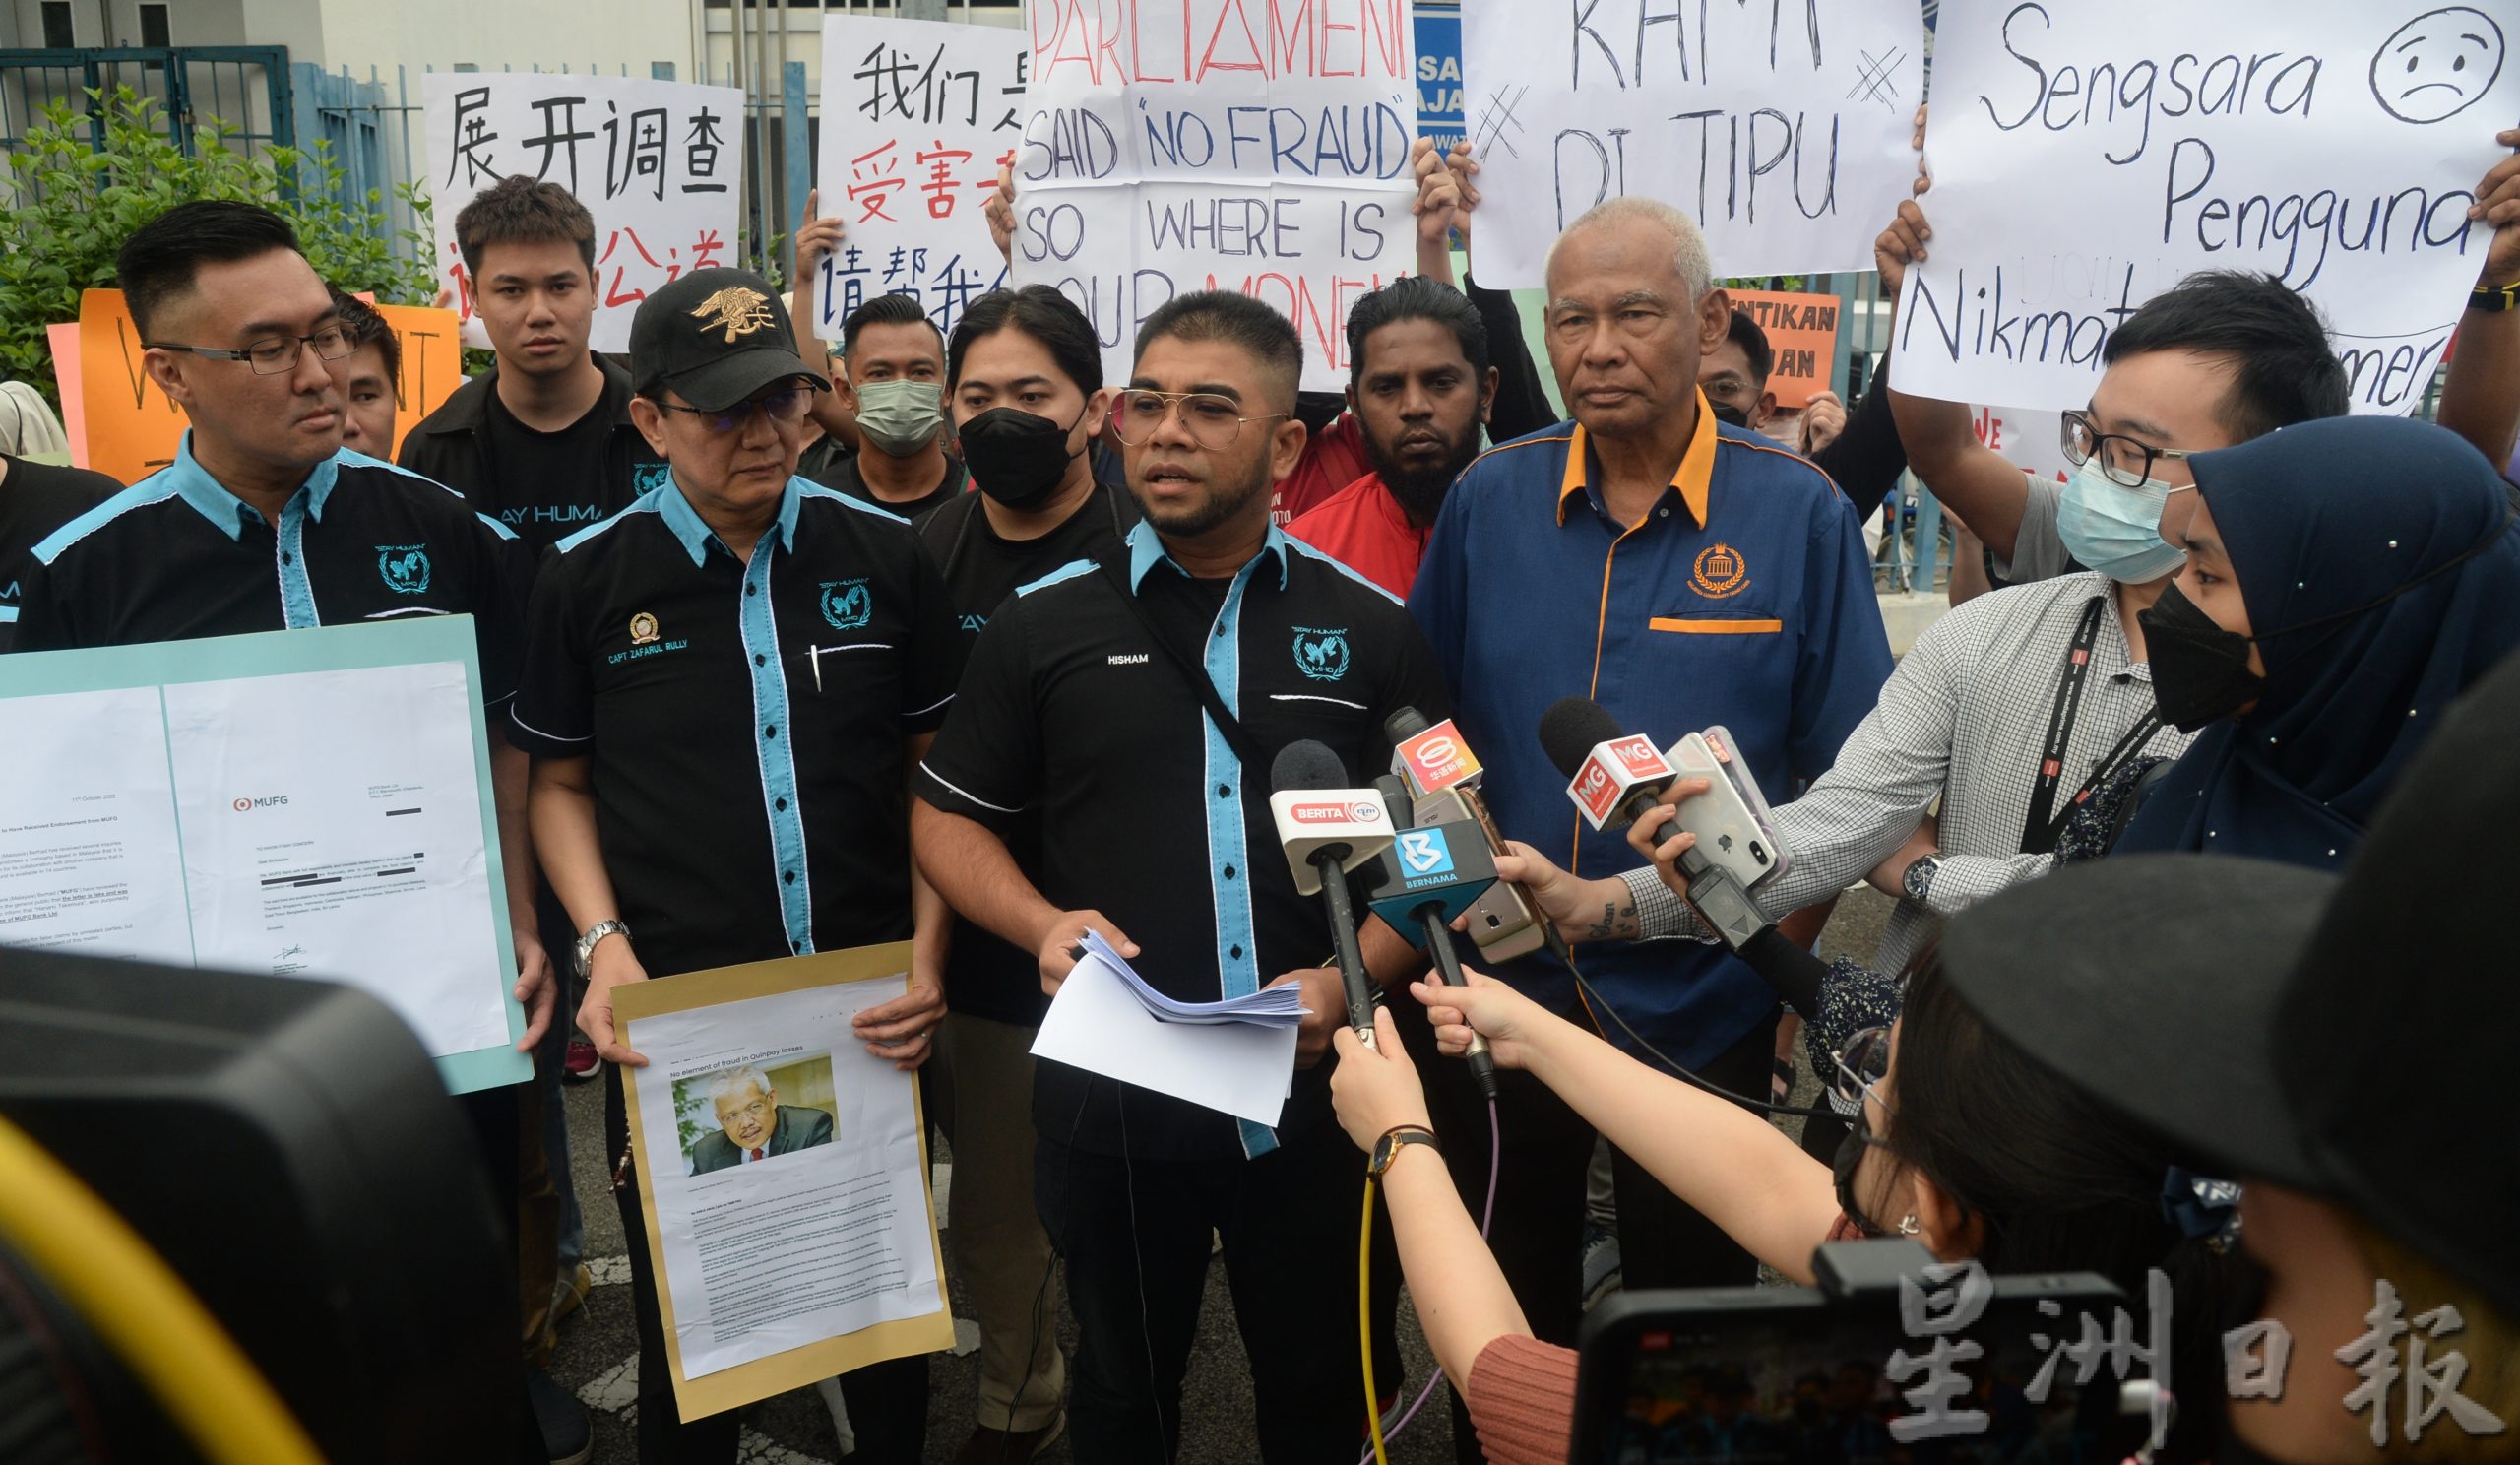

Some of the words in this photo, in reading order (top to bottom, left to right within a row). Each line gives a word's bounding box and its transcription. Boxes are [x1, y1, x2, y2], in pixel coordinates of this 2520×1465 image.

[1979, 2, 2322, 165] Sengsara
[445, 86, 727, 202] 展开调查
[1024, 107, 1118, 180] SAID
[1667, 107, 1839, 228] TIPU
[1021, 203, 1085, 261] SO
[1147, 198, 1301, 258] WHERE
[1340, 200, 1384, 260] IS
[2164, 138, 2475, 291] Pengguna
[820, 243, 1010, 334] 请帮我
[608, 650, 628, 665] CAPT
[665, 639, 688, 652] RULLY
[1107, 653, 1149, 665] HISHAM
[1614, 742, 1653, 764] MG
[254, 796, 288, 808] MUFG
[1577, 765, 1606, 804] MG
[50, 819, 87, 828] Endorsement
[1296, 808, 1344, 819] BERITA
[1406, 873, 1458, 889] BERNAMA
[681, 1063, 712, 1076] element
[721, 1056, 741, 1068] fraud
[749, 1049, 780, 1060] Quinpay
[781, 1045, 803, 1053] losses
